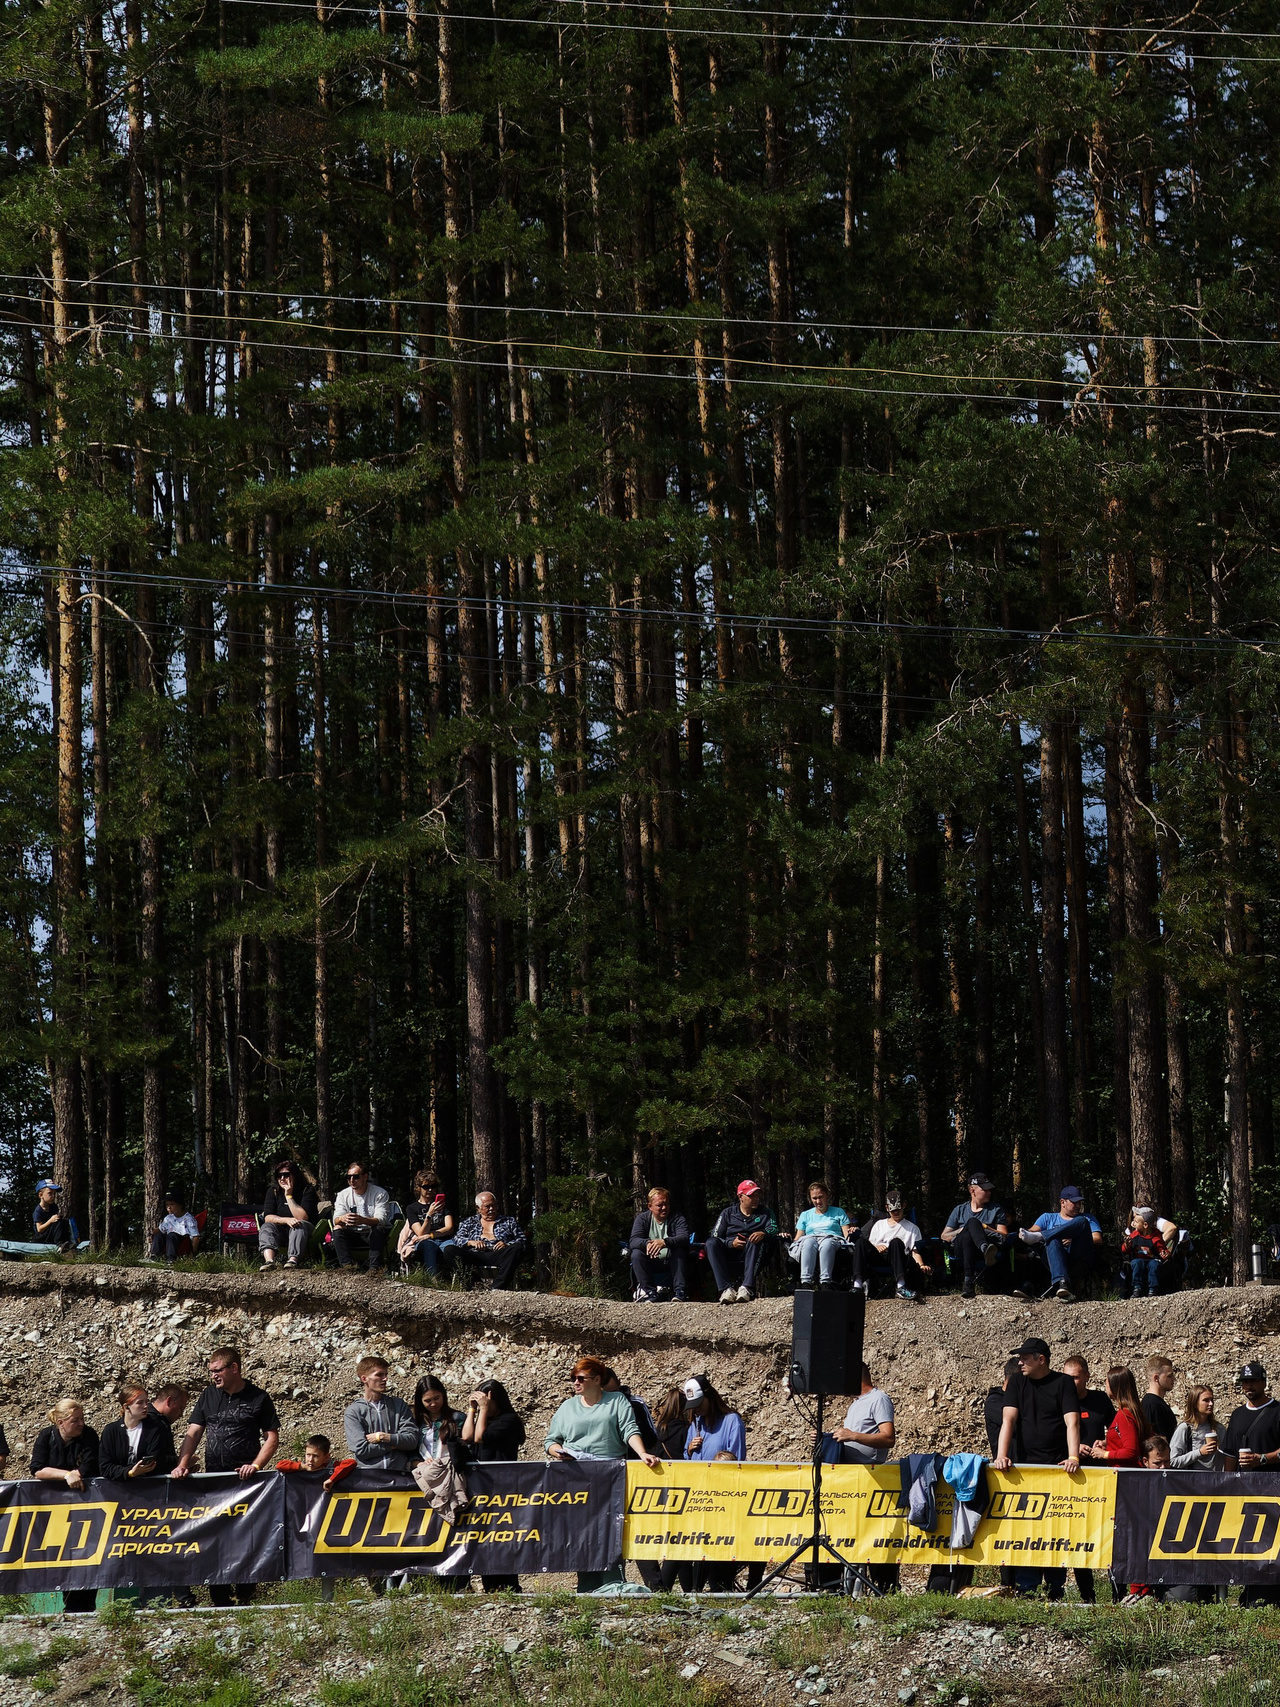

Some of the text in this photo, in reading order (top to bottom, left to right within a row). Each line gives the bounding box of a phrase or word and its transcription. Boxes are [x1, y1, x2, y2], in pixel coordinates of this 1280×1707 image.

[630, 1488, 688, 1514] ULD
[691, 1490, 747, 1498] УРАЛЬСКАЯ
[1051, 1495, 1107, 1503] УРАЛЬСКАЯ
[685, 1505, 726, 1513] ДРИФТА
[750, 1490, 808, 1516] ULD
[990, 1493, 1047, 1519] ULD
[121, 1503, 249, 1521] УРАЛЬСКАЯ
[457, 1512, 513, 1526] ЛИГА
[1044, 1511, 1086, 1519] ДРИФТА
[324, 1496, 443, 1548] ULD
[113, 1524, 172, 1538] ЛИГА
[450, 1528, 540, 1547] ДРИФТА
[634, 1531, 735, 1546] uraldrift.ru
[107, 1541, 200, 1559] ДРИФТА
[993, 1537, 1095, 1553] uraldrift.ru
